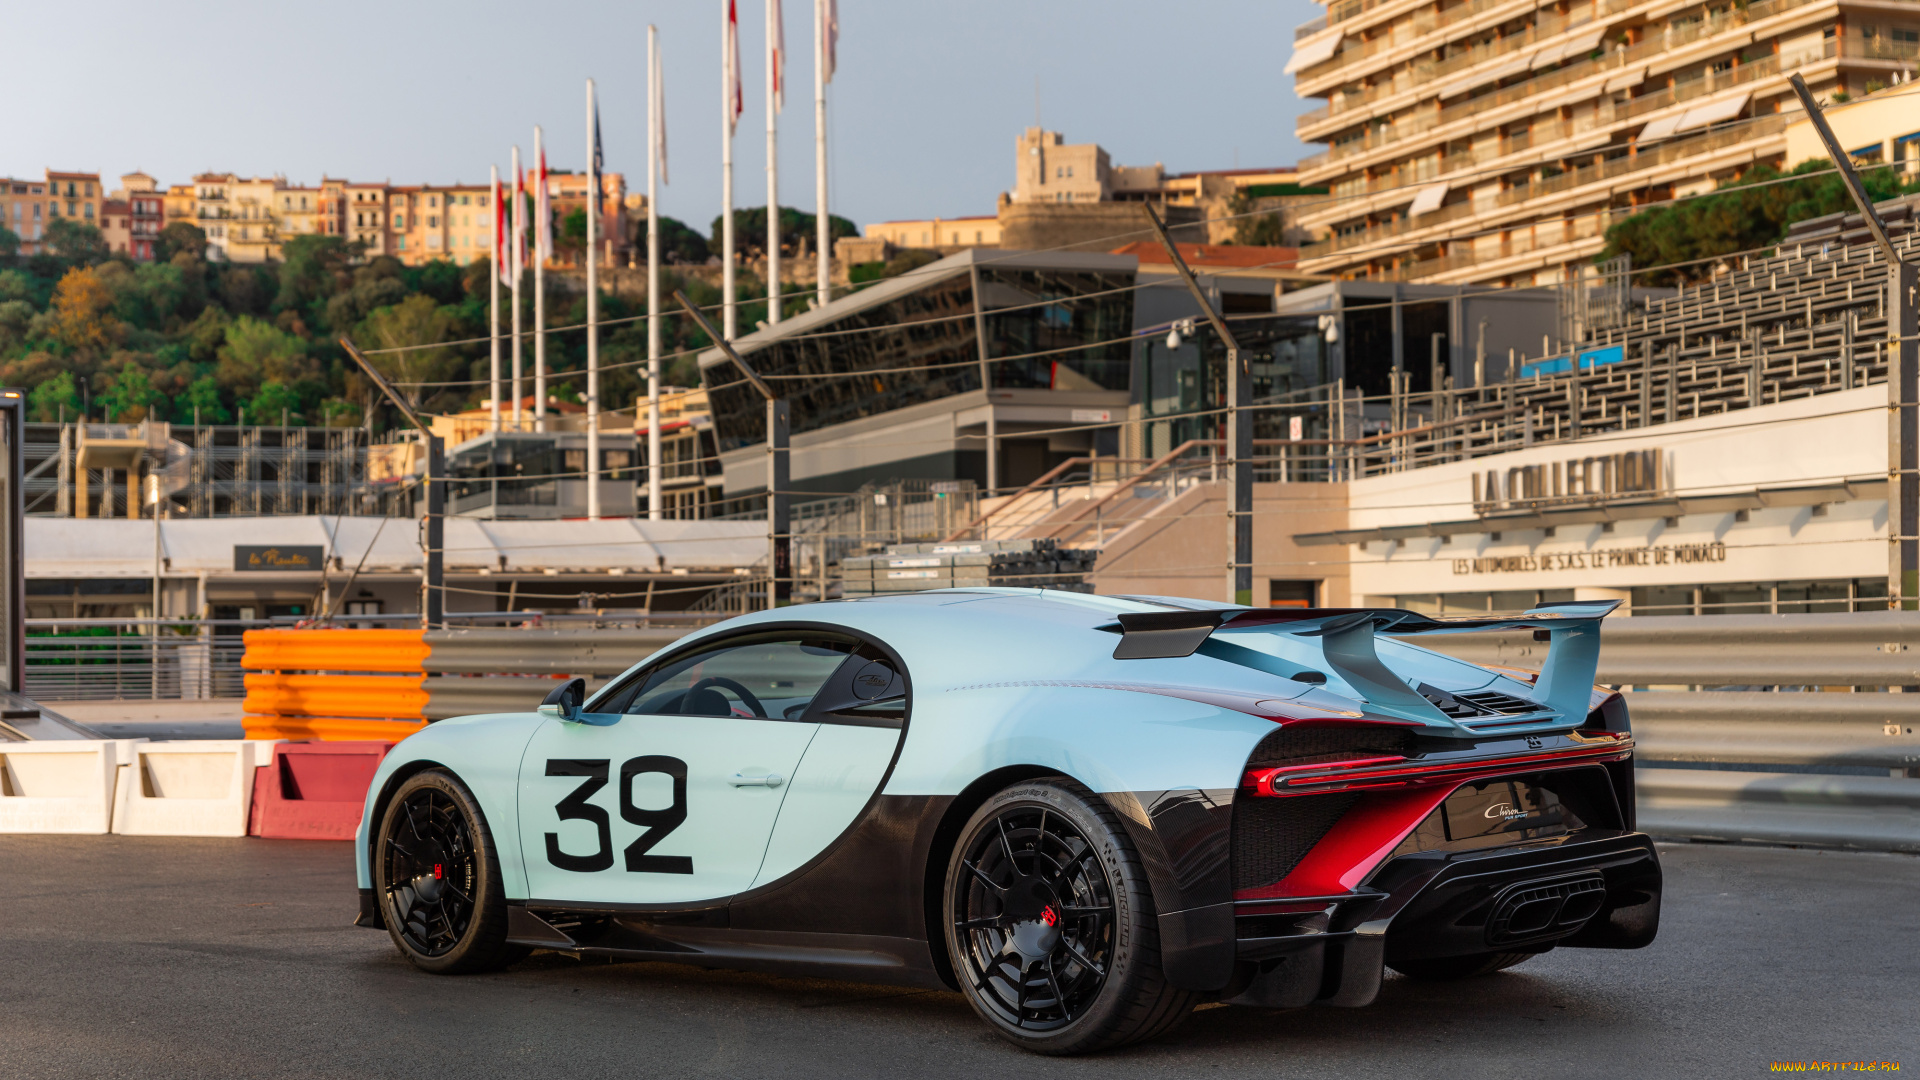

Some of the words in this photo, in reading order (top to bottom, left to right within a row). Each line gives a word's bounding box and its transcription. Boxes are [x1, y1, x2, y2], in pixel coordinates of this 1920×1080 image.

[1453, 558, 1469, 574] LES
[1473, 555, 1537, 573] AUTOMOBILES
[1541, 553, 1553, 571] DE
[1592, 549, 1603, 567] LE
[1609, 547, 1649, 567] PRINCE
[1655, 545, 1669, 564] DE
[1674, 542, 1725, 563] MONACO
[544, 755, 694, 875] 32
[1484, 803, 1528, 819] Chiron
[1116, 884, 1129, 947] MICHELIN
